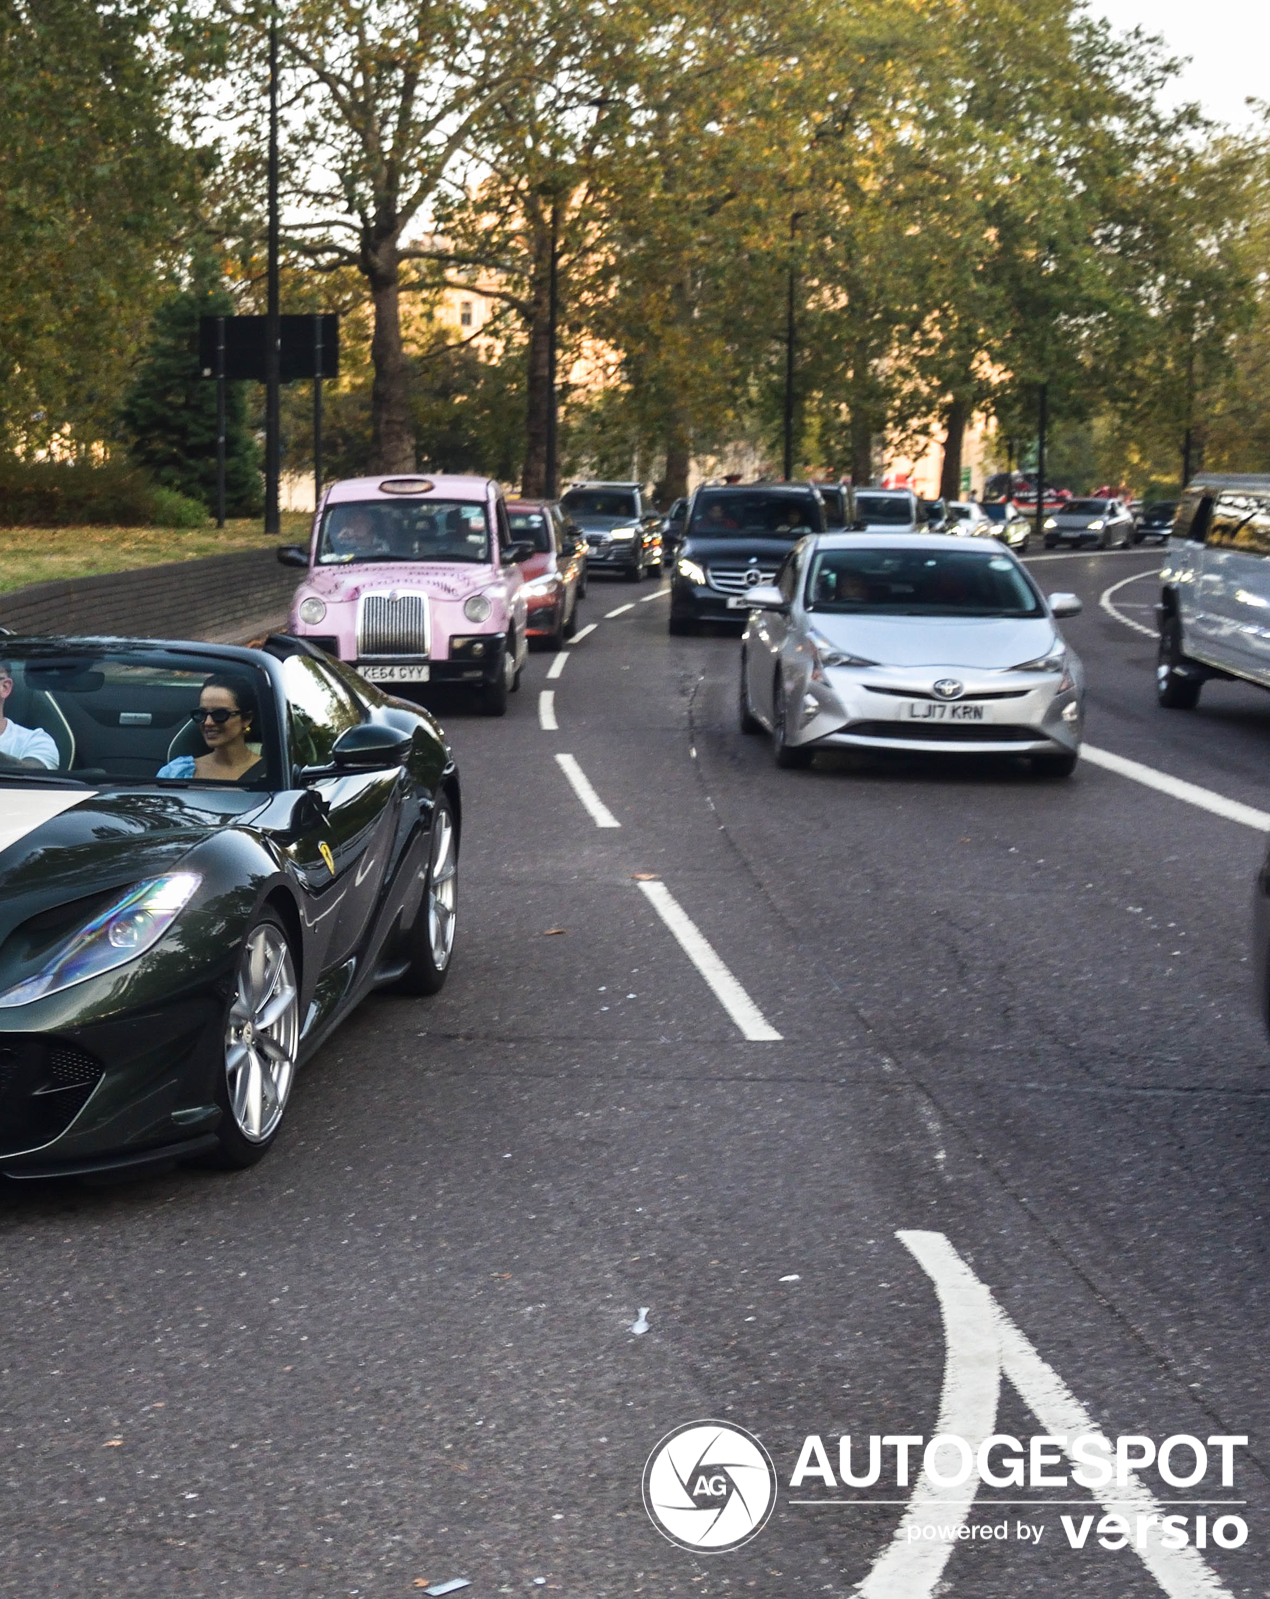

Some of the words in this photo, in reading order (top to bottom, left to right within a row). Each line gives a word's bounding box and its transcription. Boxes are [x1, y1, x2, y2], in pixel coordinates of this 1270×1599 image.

[363, 666, 395, 679] KE64
[910, 703, 947, 719] LJ17
[951, 705, 984, 720] KRN
